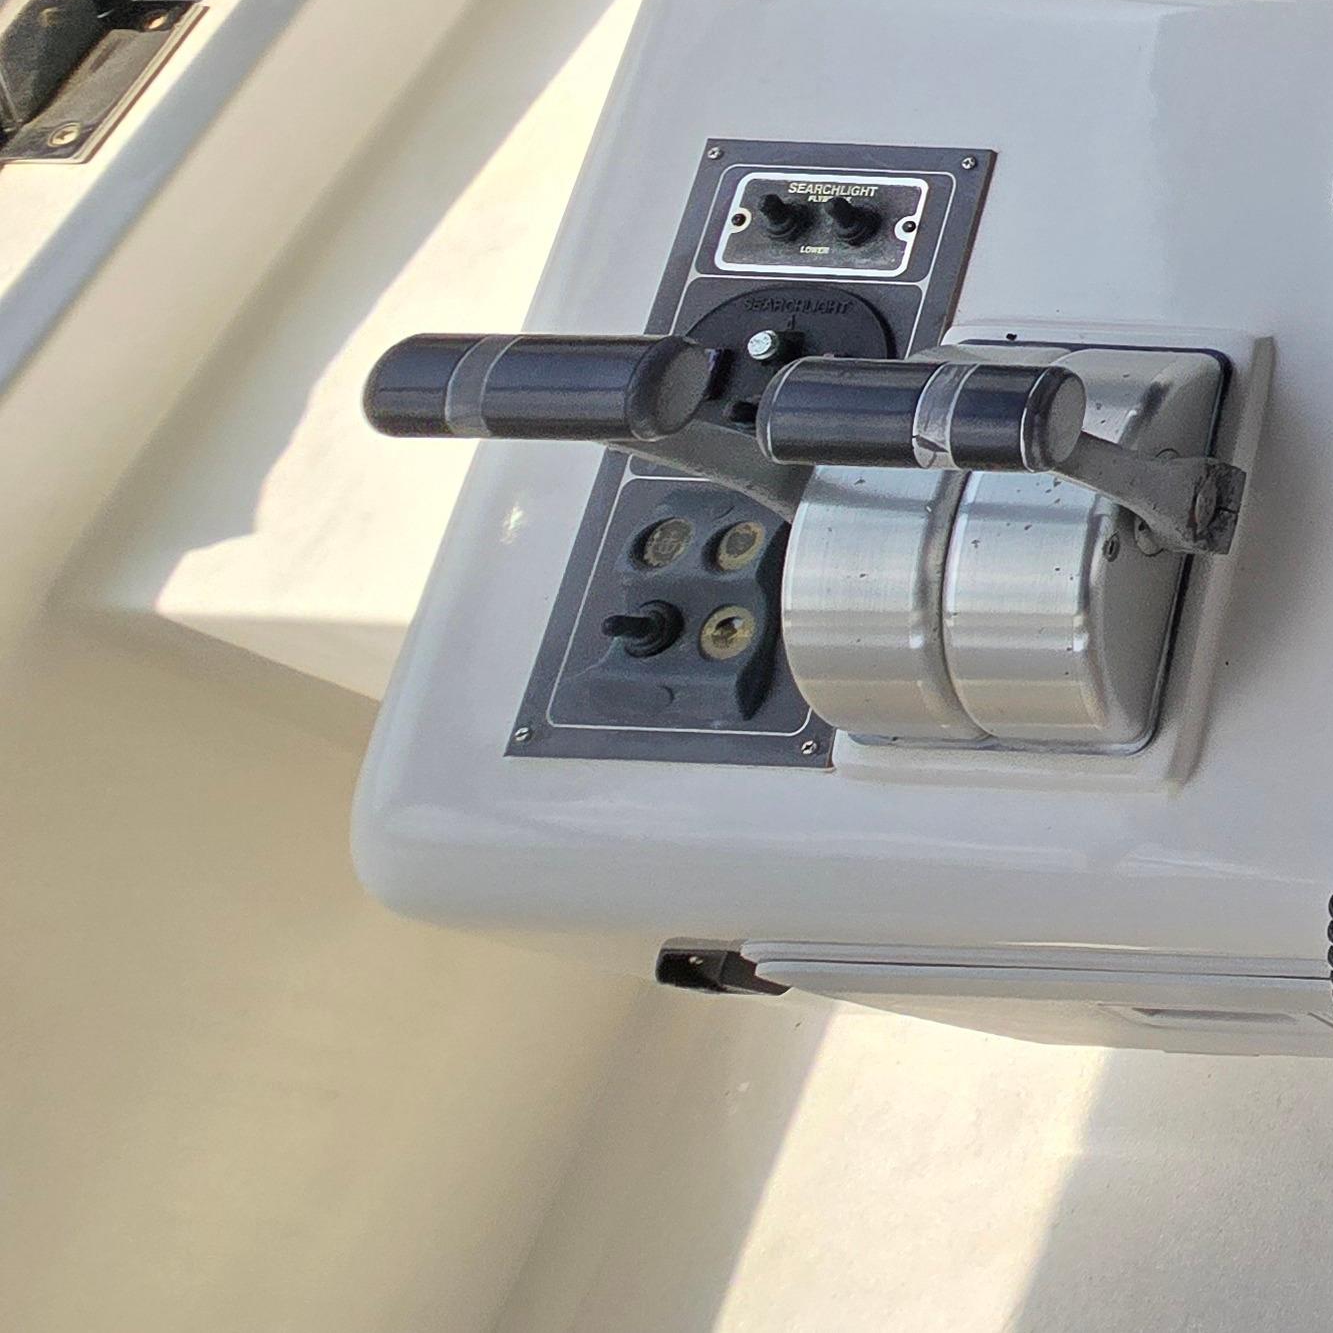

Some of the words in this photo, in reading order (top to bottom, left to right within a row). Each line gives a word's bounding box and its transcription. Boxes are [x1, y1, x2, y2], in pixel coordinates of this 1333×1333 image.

[788, 182, 878, 197] SEARCHLIGHT
[800, 245, 830, 255] LOWER
[743, 297, 854, 314] SEARCHLIGHT
